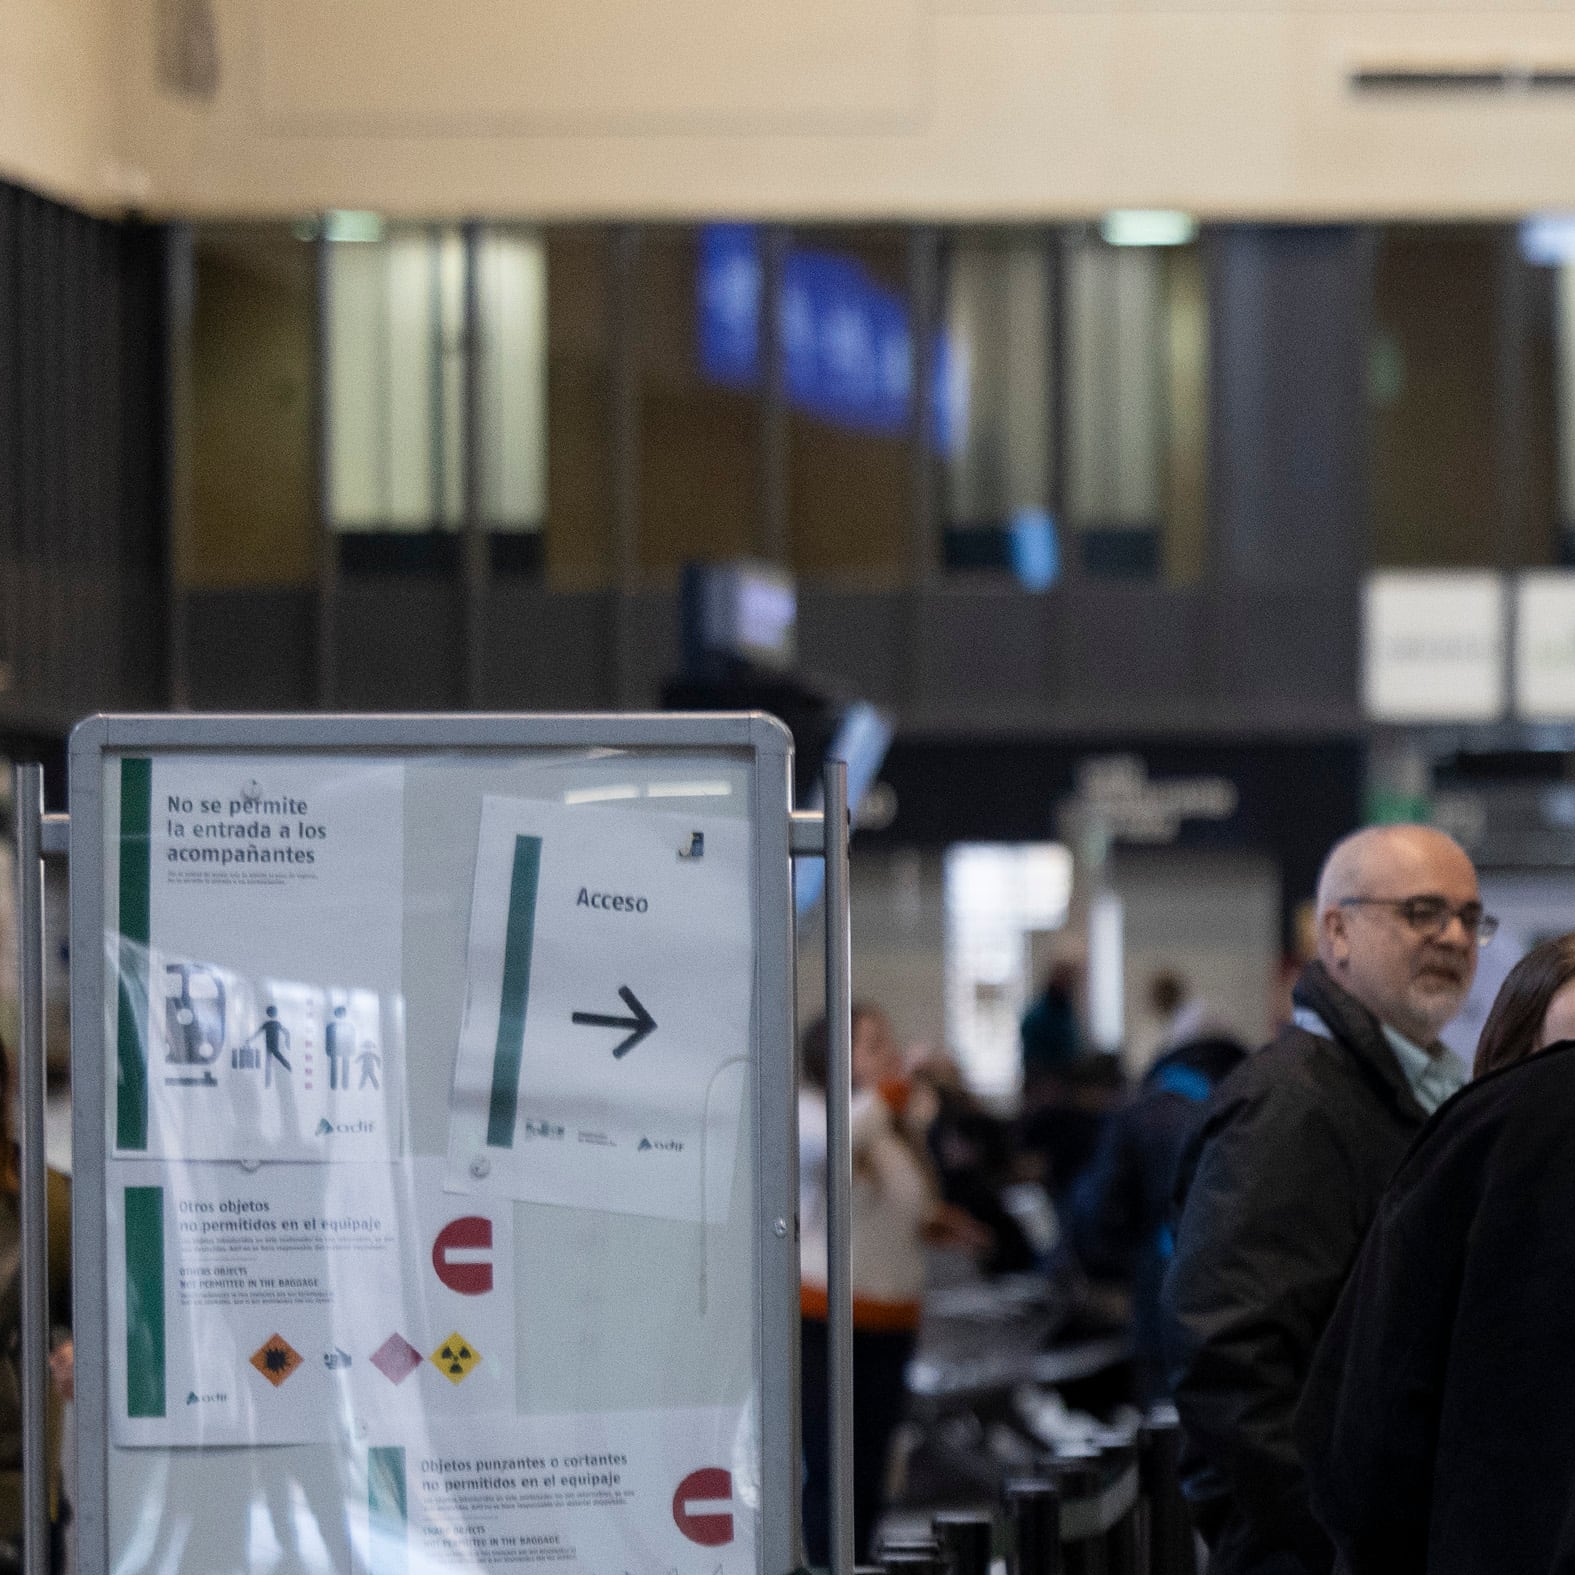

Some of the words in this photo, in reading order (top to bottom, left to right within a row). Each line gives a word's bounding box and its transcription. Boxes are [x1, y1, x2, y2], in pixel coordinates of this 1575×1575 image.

[167, 796, 193, 813] No
[201, 799, 222, 814] se
[229, 796, 308, 817] permite
[168, 820, 185, 838] la
[193, 821, 271, 839] entrada
[279, 825, 290, 839] a
[299, 821, 327, 840] los
[167, 844, 315, 866] acompañantes
[576, 887, 649, 914] Acceso
[179, 1200, 215, 1213] Otros
[219, 1199, 270, 1215] objetos
[180, 1221, 198, 1233] no
[202, 1218, 277, 1234] permitidos
[281, 1220, 299, 1232] en
[304, 1217, 317, 1230] el
[321, 1216, 382, 1232] equipaje
[213, 1266, 248, 1277] OBJECTS
[199, 1279, 245, 1289] PERMITTED
[248, 1279, 257, 1289] IN
[260, 1279, 275, 1289] THE
[278, 1278, 319, 1288] BAGGAGE
[421, 1458, 472, 1474] Objetos
[476, 1456, 546, 1472] punzantes
[551, 1456, 559, 1468] o
[564, 1452, 628, 1467] cortantes
[422, 1479, 440, 1491] no
[445, 1475, 517, 1492] permitidos
[521, 1476, 539, 1489] en
[543, 1474, 556, 1488] el
[560, 1471, 621, 1488] equipaje
[489, 1537, 500, 1547] IN
[501, 1536, 516, 1546] THE
[519, 1534, 561, 1546] BAGGAGE
